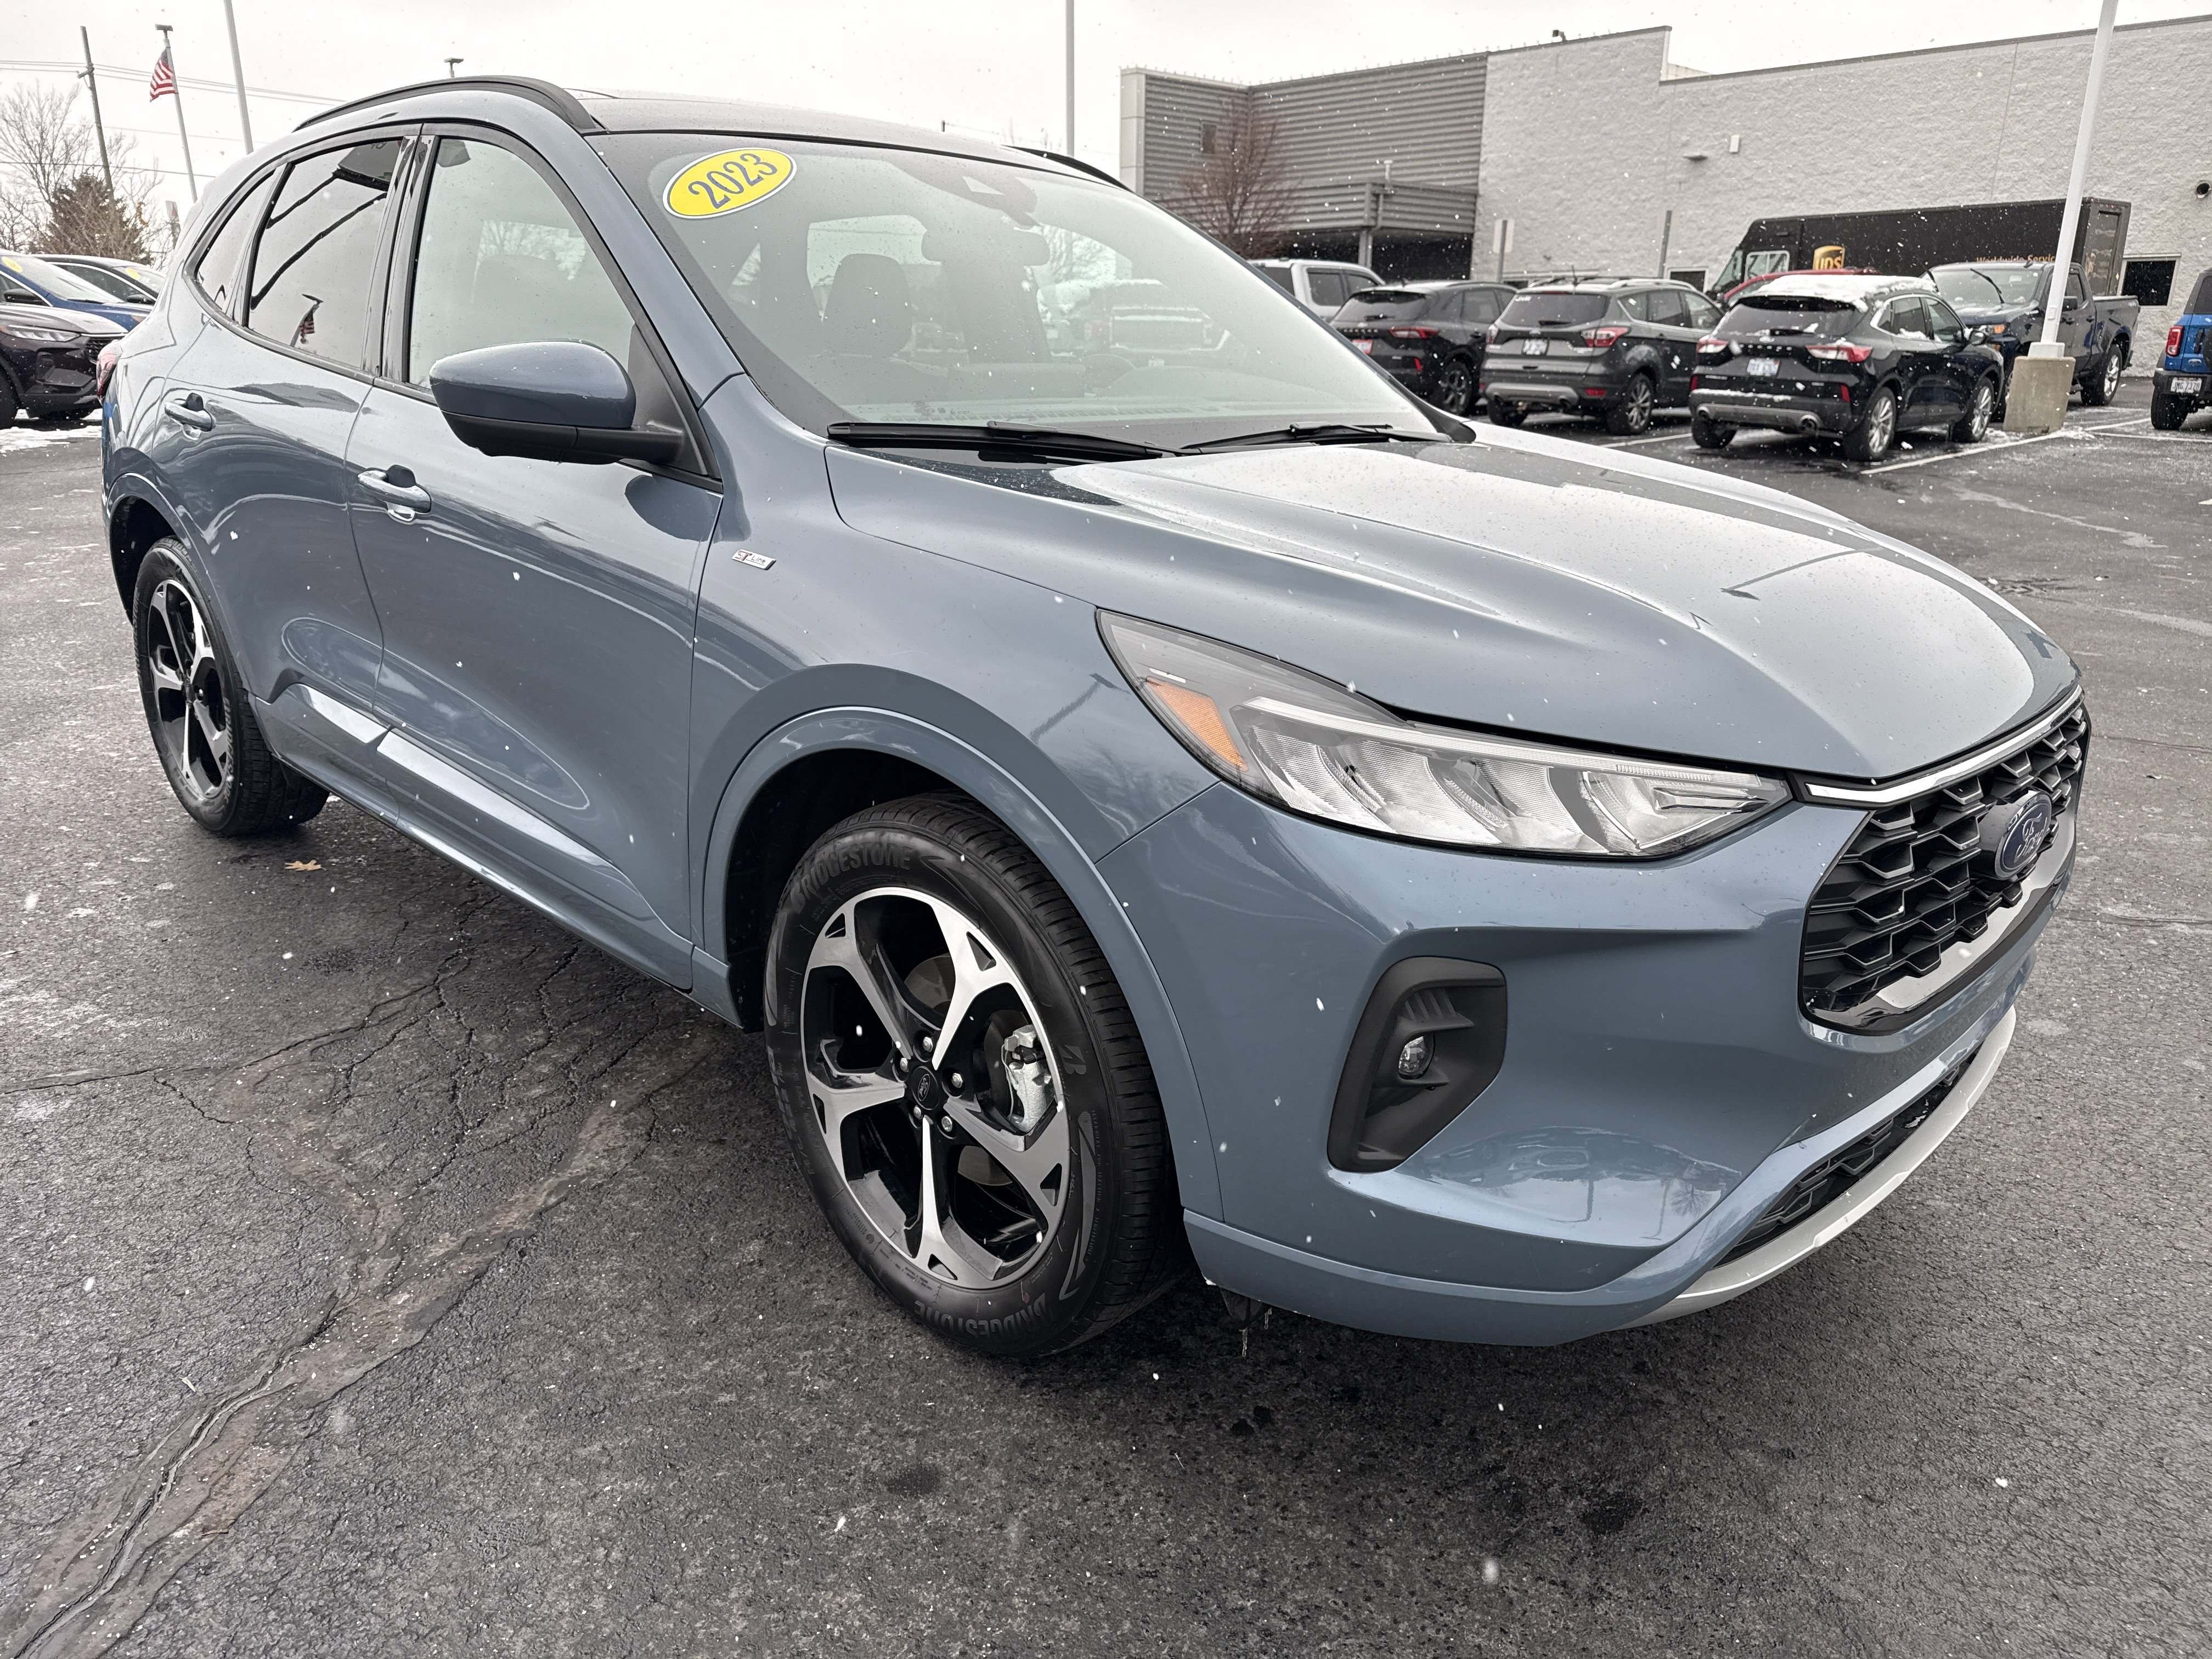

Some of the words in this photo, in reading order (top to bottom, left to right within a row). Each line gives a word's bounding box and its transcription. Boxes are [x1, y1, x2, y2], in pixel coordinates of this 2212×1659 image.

[688, 153, 777, 209] 2023
[735, 550, 753, 561] ST
[2014, 812, 2048, 864] Ford
[790, 841, 912, 915] BRIDGESTONE
[918, 1077, 928, 1098] Ford
[914, 1293, 1046, 1339] BRIDGESTONE
